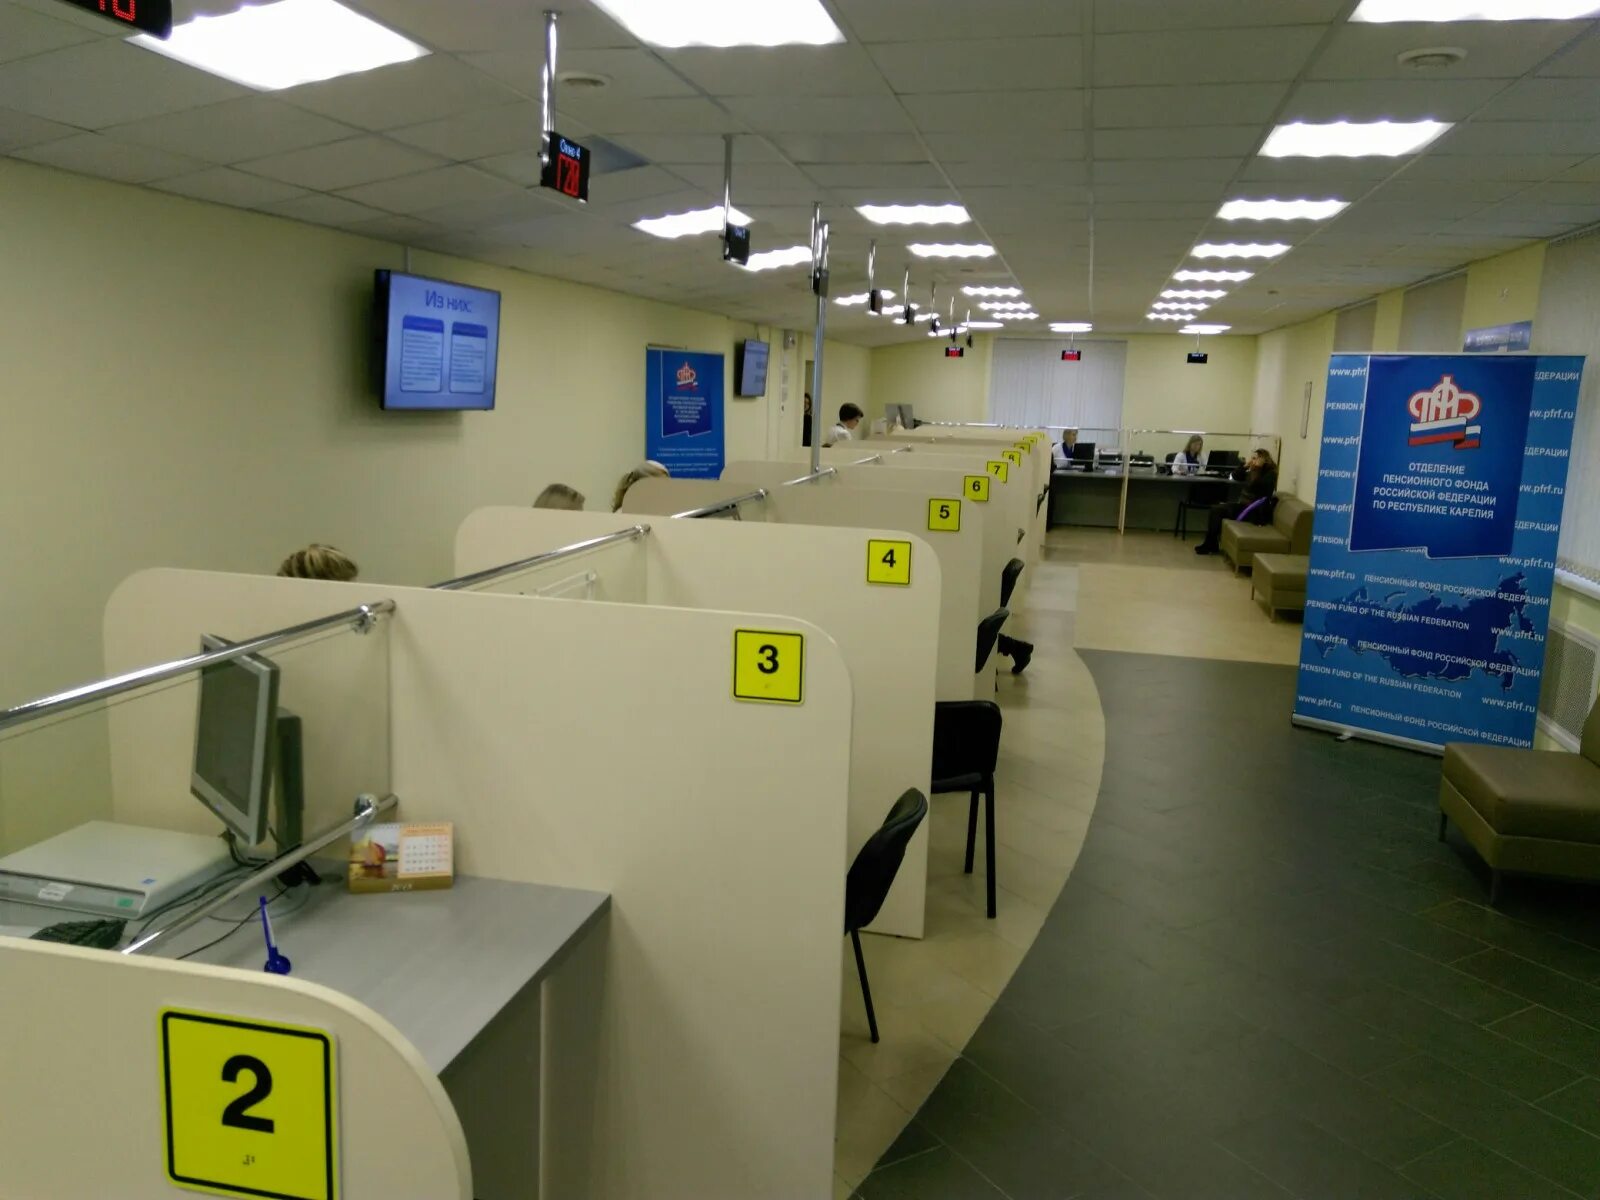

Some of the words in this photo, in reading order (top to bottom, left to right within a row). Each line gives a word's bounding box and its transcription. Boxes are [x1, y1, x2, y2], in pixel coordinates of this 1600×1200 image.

[425, 289, 444, 309] Из
[1326, 402, 1358, 411] PENSION
[994, 465, 1000, 474] 7
[1320, 469, 1350, 478] PENSION
[1409, 462, 1465, 475] ОТДЕЛЕНИЕ
[973, 481, 980, 491] 6
[1383, 474, 1453, 487] ПЕНСИОННОГО
[1455, 480, 1489, 491] ФОНДА
[1373, 487, 1435, 500] РОССИЙСКОЙ
[1438, 492, 1497, 506] ФЕДЕРАЦИИ
[940, 505, 949, 519] 5
[1373, 500, 1386, 509] ПО
[1388, 501, 1447, 515] РЕСПУБЛИКЕ
[1450, 507, 1494, 519] КАРЕЛИЯ
[1313, 535, 1343, 545] PENSION
[882, 549, 896, 568] 4
[1499, 557, 1554, 569] www.pfrf.ru
[1310, 568, 1355, 580] www.pfrf.ru
[1365, 574, 1418, 588] ПЕНСИОННЫЙ
[1419, 582, 1441, 592] ФОНД
[1443, 584, 1496, 599] РОССИЙСКОЙ
[1498, 592, 1549, 605] ФЕДЕРАЦИИ
[1306, 599, 1337, 610] PENSION
[1339, 603, 1358, 613] FUND
[1359, 607, 1370, 615] OF
[1371, 608, 1385, 618] THE
[1387, 610, 1420, 623] RUSSIAN
[1421, 616, 1469, 630] FEDERATION
[1491, 627, 1544, 642] www.pfrf.ru
[757, 644, 779, 674] 3
[1304, 632, 1348, 645] www.pfrf.ru
[1358, 639, 1410, 655] ПЕНСИОННЫЙ
[1411, 649, 1433, 660] ФОНД
[1435, 653, 1487, 668] РОССИЙСКОЙ
[1489, 662, 1540, 678] ФЕДЕРАЦИИ
[1301, 663, 1331, 674] PENSION
[1332, 668, 1351, 679] FUND
[1352, 672, 1362, 680] OF
[1364, 674, 1378, 684] THE
[1380, 677, 1412, 690] RUSSIAN
[1413, 683, 1462, 698] FEDERATION
[1482, 697, 1536, 713] www.pfrf.ru
[1298, 695, 1342, 709] www.pfrf.ru
[1350, 704, 1402, 721] ПЕНСИОННЫЙ
[1403, 716, 1426, 727] ФОНД
[1427, 721, 1479, 737] РОССИЙСКОЙ
[1481, 731, 1531, 748] ФЕДЕРАЦИИ
[222, 1055, 274, 1133] 2
